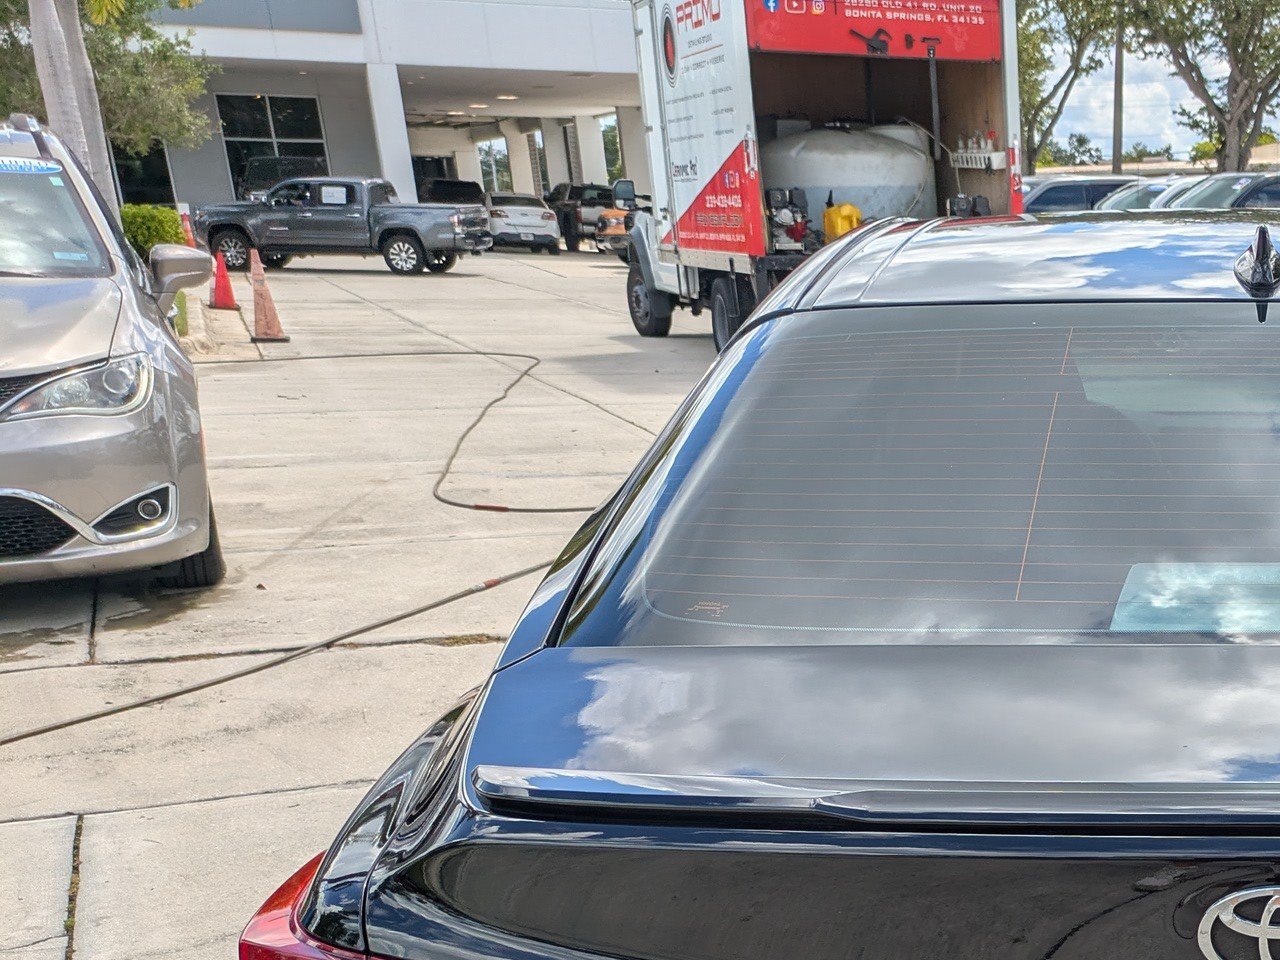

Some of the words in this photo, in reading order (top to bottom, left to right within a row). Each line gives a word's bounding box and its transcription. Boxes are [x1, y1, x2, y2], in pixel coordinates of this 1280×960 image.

[881, 0, 902, 8] OLD
[942, 4, 965, 12] UNIT
[845, 10, 882, 18] BONITA
[886, 12, 934, 22] SPRINGS,
[952, 15, 984, 24] 34135
